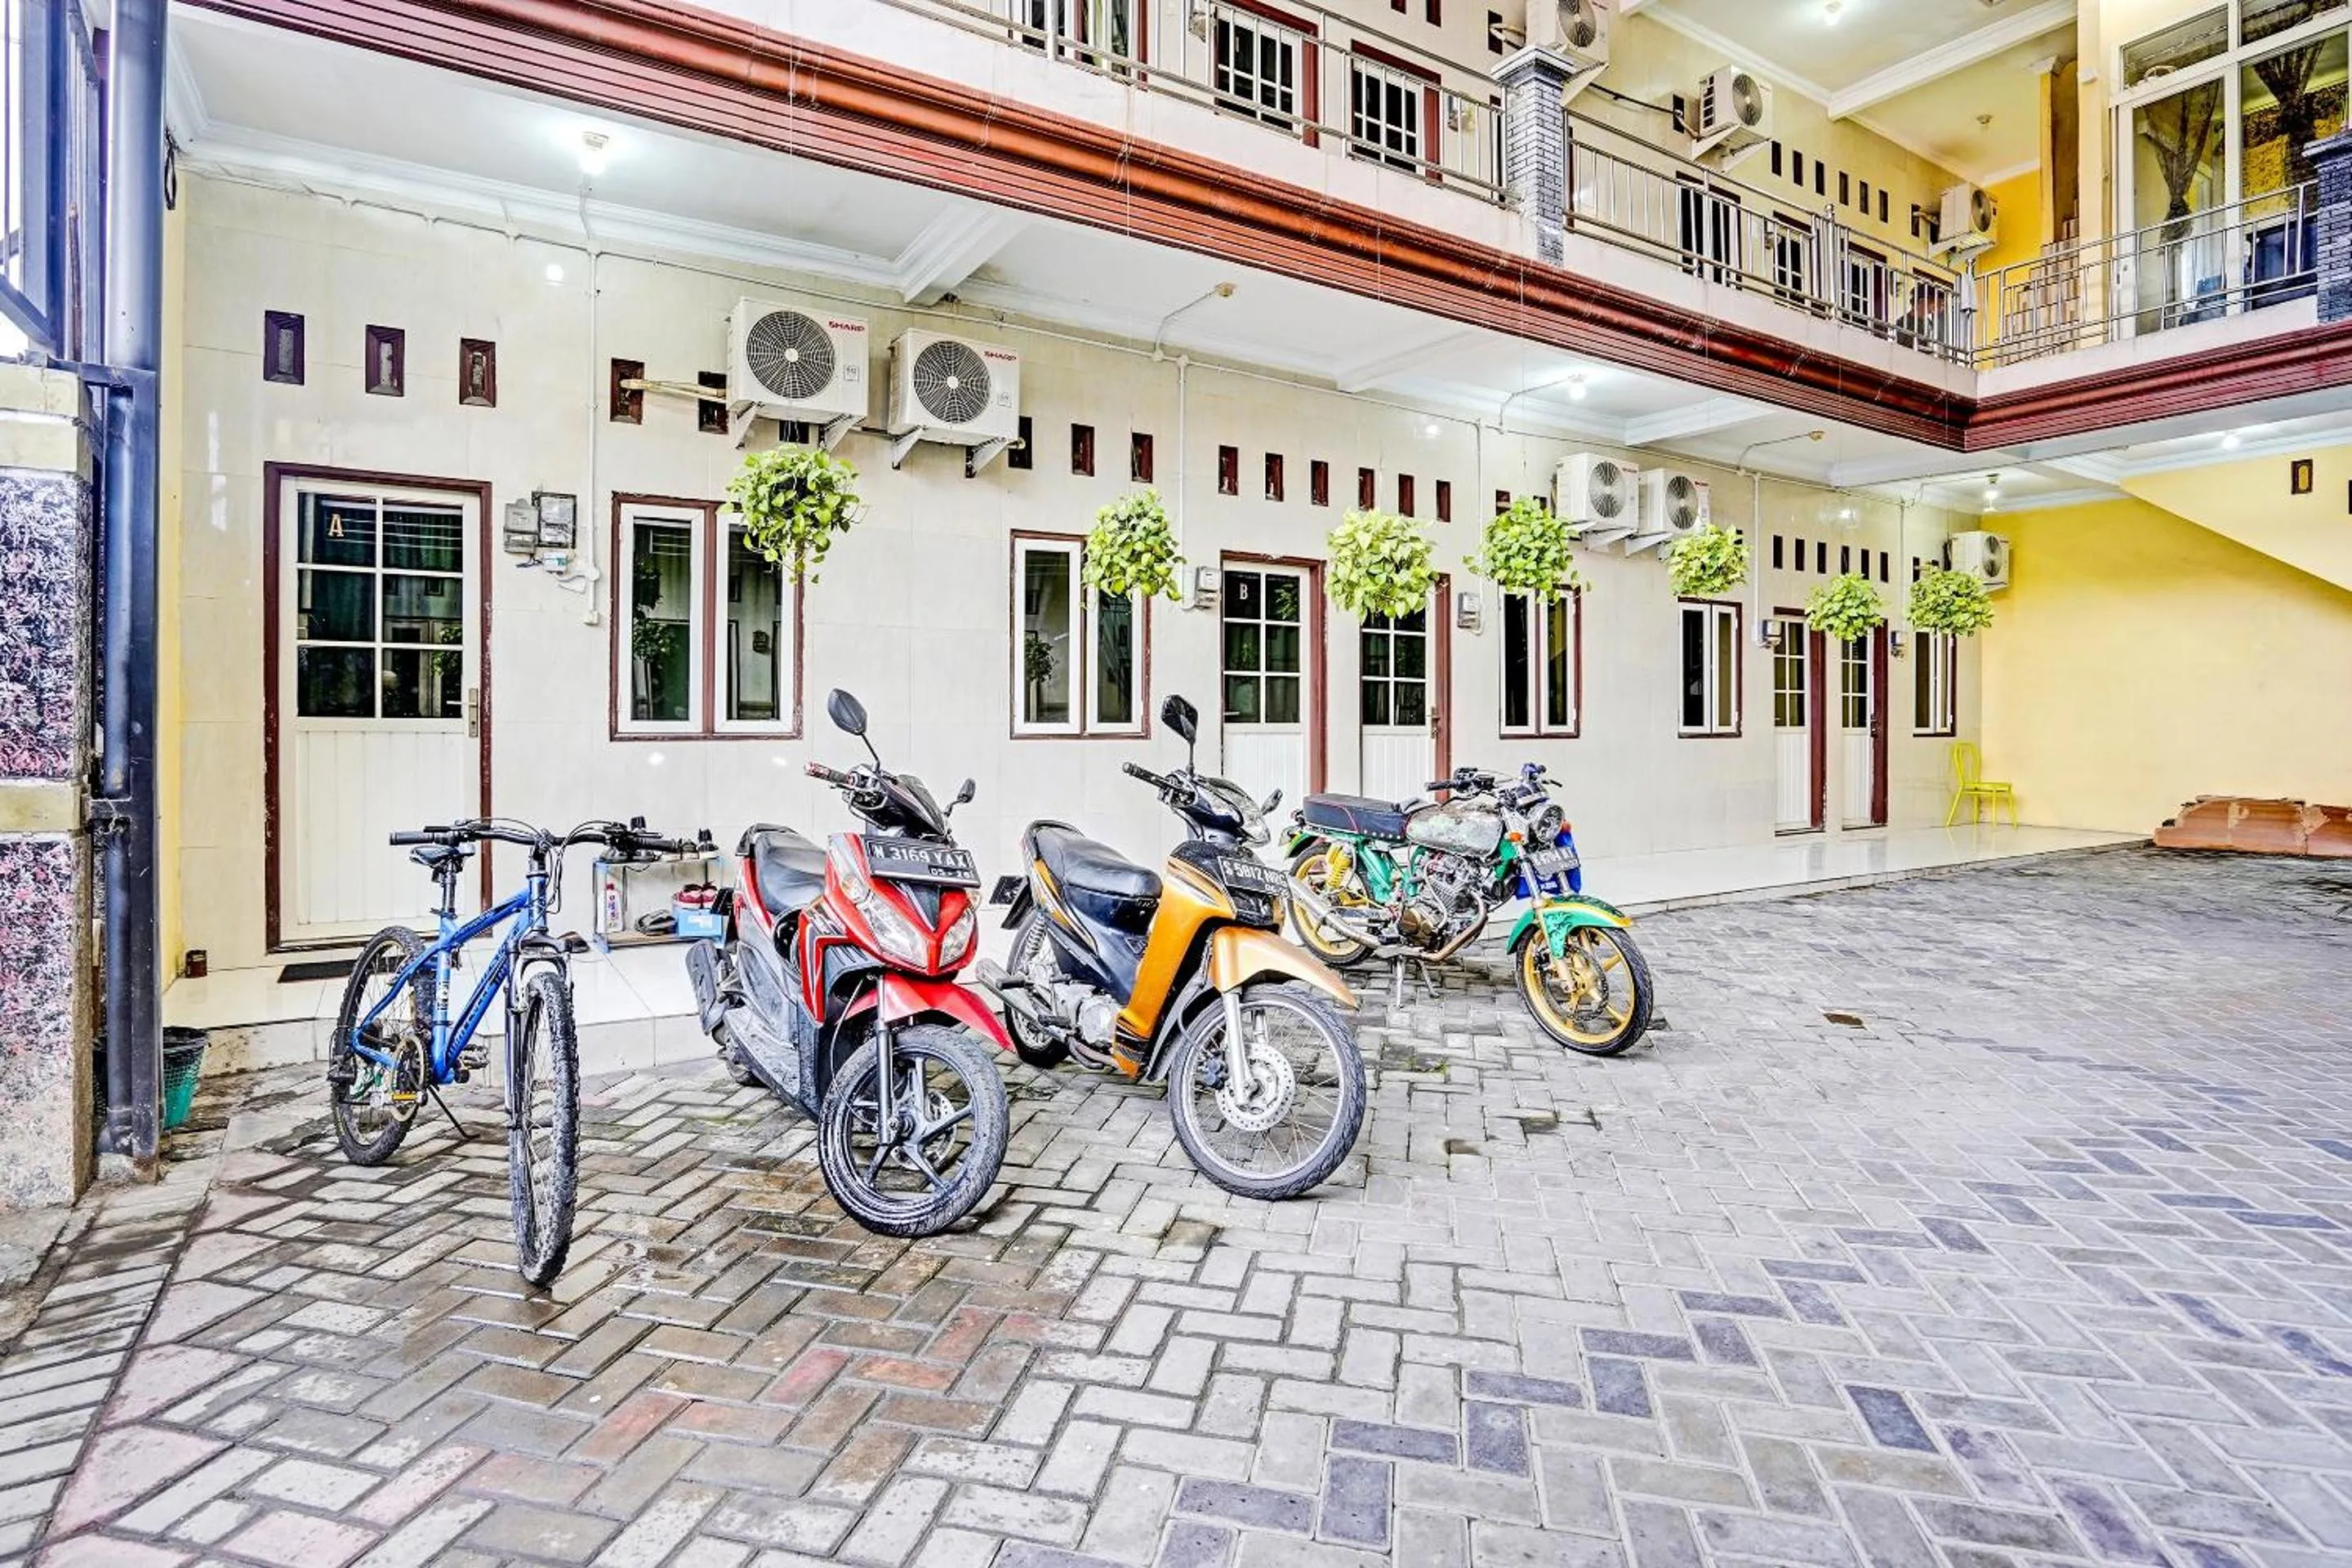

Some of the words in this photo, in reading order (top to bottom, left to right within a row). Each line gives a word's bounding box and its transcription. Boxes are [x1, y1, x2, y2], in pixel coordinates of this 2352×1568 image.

[829, 321, 865, 332] SHARP
[984, 351, 1017, 361] SHARP
[327, 514, 344, 537] A
[1240, 582, 1248, 599] B
[874, 844, 884, 859] N
[889, 848, 930, 863] 3169
